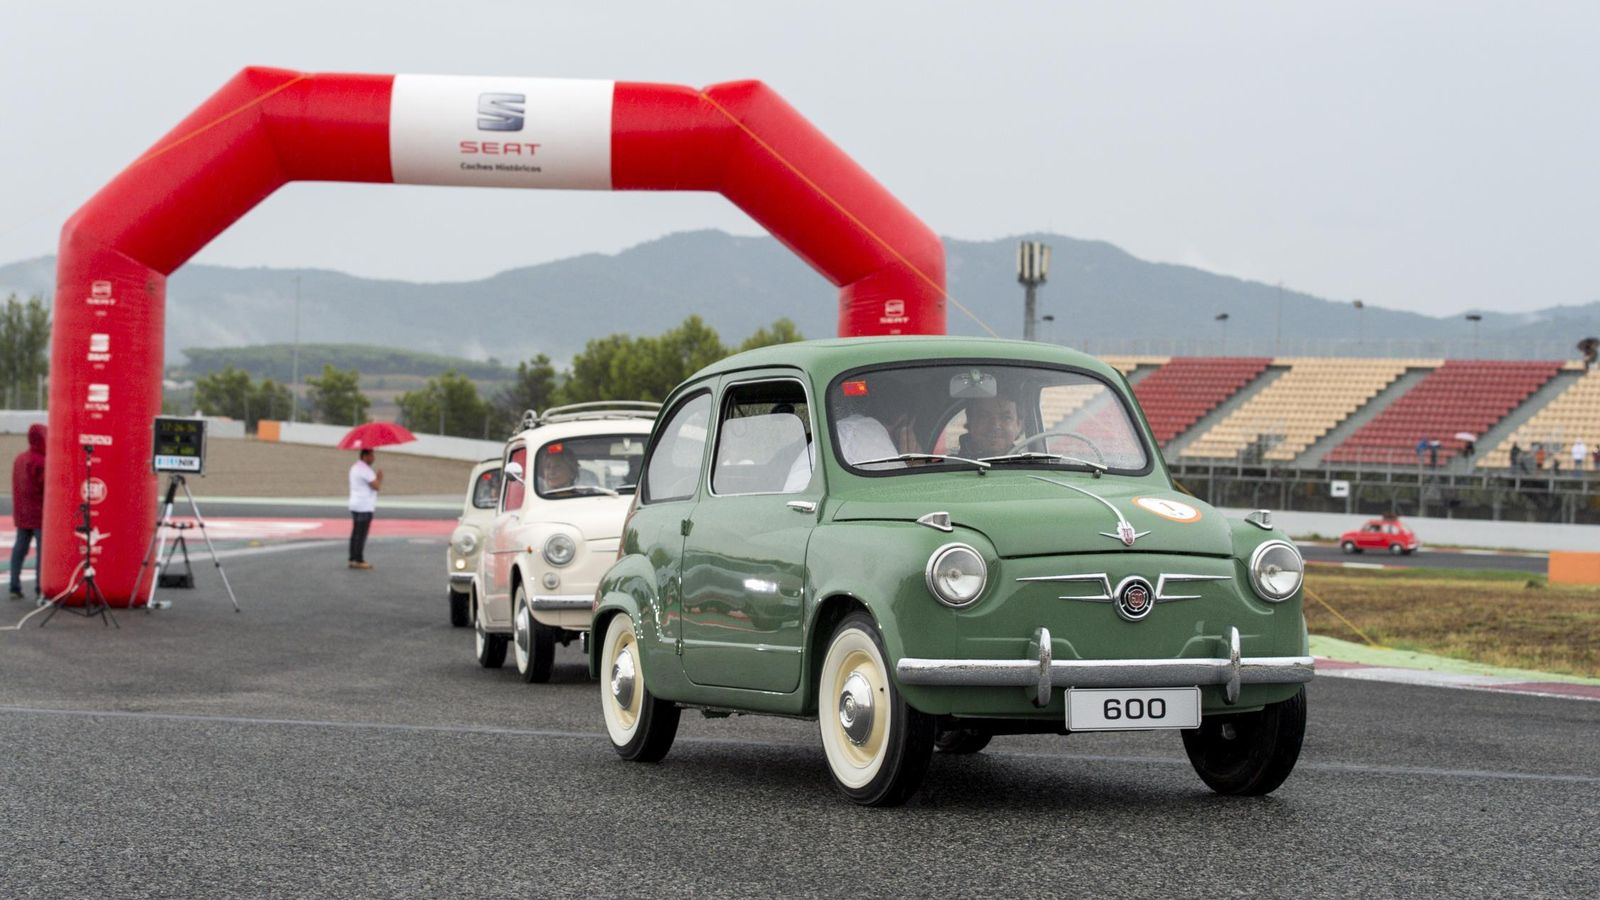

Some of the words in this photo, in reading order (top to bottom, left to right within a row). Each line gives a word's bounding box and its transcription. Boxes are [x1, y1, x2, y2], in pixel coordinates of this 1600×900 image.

[459, 140, 541, 156] SEAT
[460, 162, 493, 171] Coches
[495, 163, 542, 172] Históricos
[879, 316, 910, 324] SEAT
[1103, 697, 1167, 720] 600
